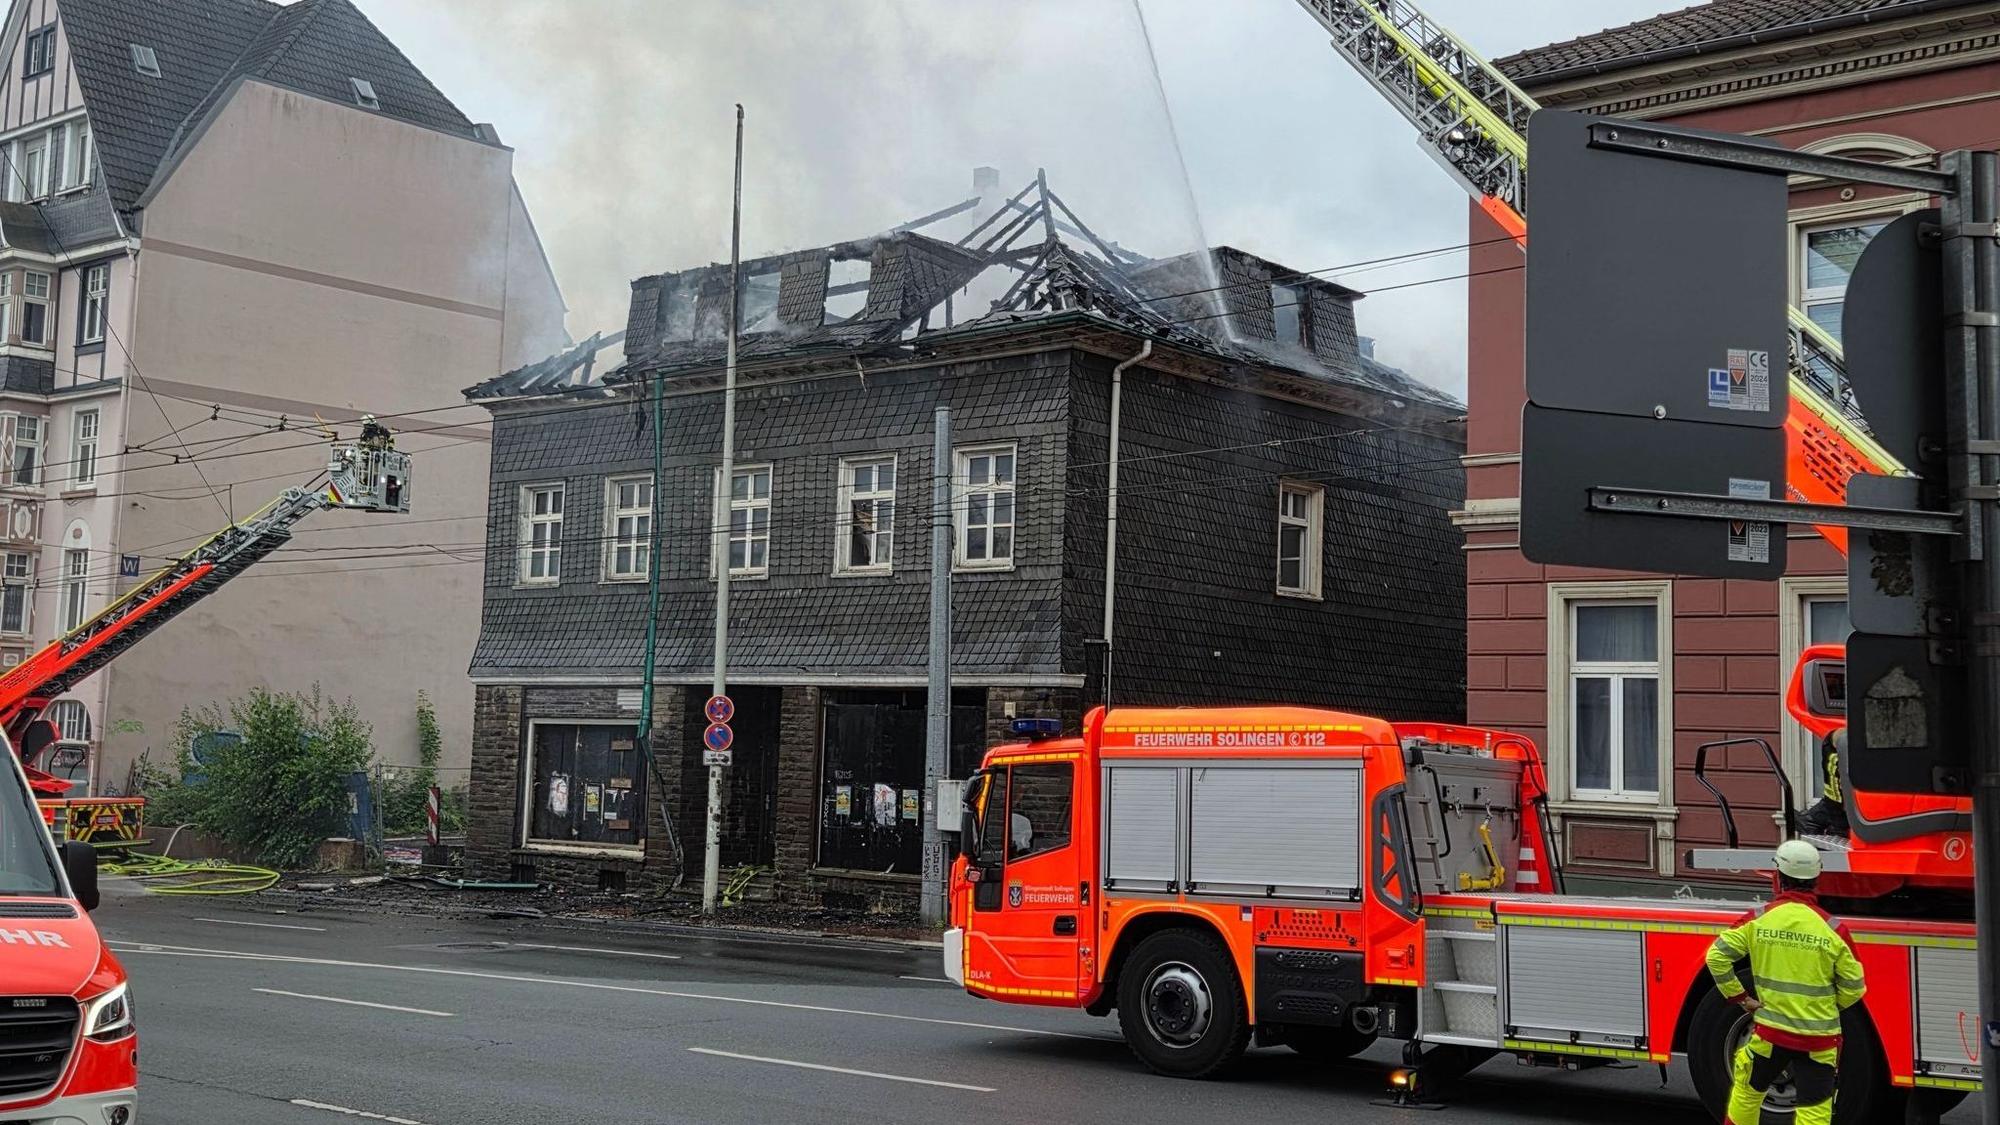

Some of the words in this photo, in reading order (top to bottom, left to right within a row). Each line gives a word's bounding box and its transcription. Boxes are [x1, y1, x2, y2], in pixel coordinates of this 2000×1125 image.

[1750, 352, 1767, 368] CE
[1750, 375, 1768, 383] 2024
[1750, 523, 1768, 533] 2023
[123, 559, 138, 573] W
[1134, 733, 1213, 746] FEUERWEHR
[1217, 733, 1284, 746] SOLINGEN
[1303, 733, 1325, 746] 112
[1024, 893, 1074, 903] FEUERWEHR
[0, 929, 71, 948] HR
[1756, 928, 1830, 948] FEUERWEHR
